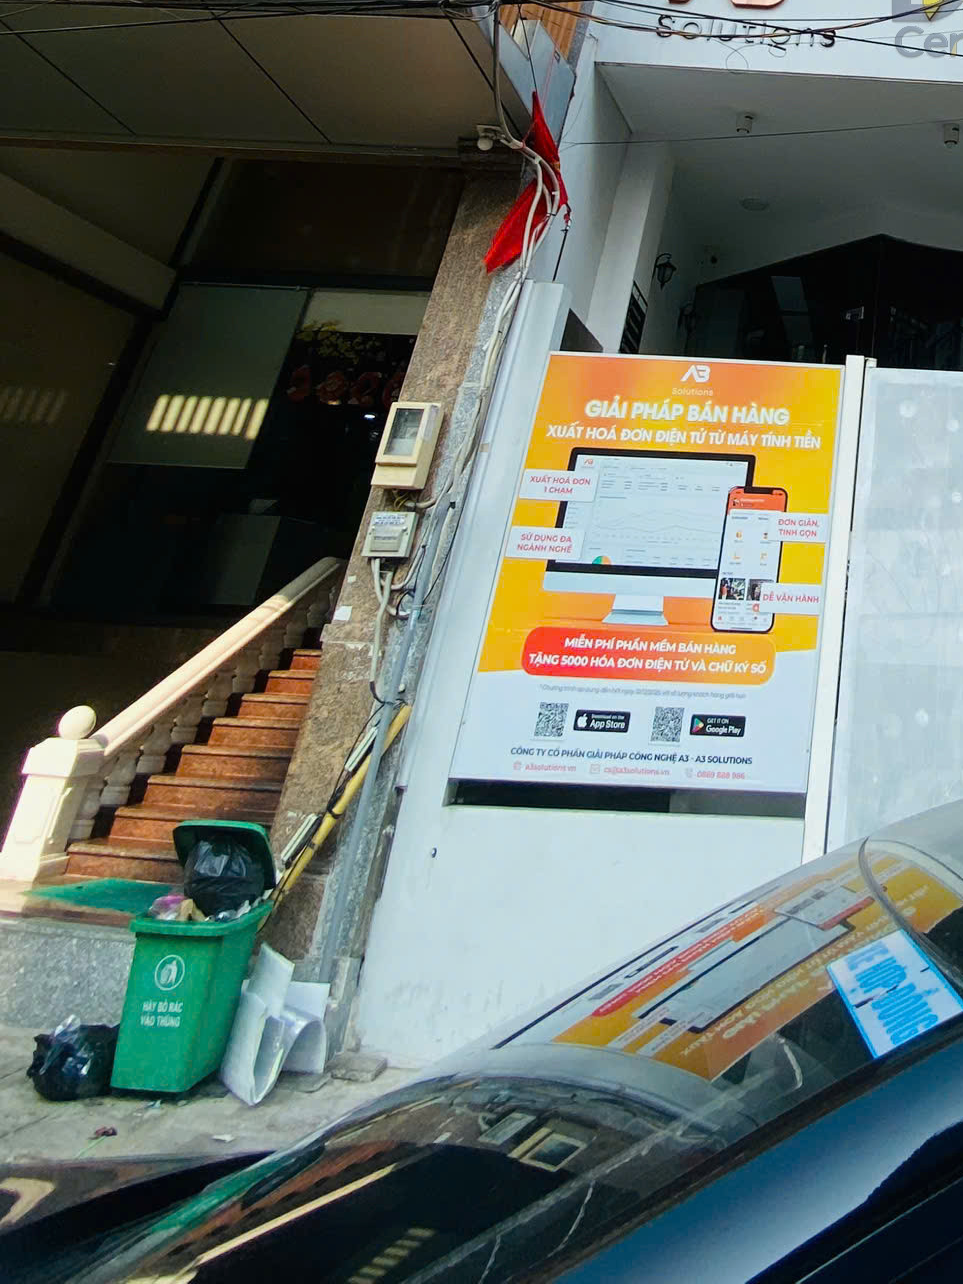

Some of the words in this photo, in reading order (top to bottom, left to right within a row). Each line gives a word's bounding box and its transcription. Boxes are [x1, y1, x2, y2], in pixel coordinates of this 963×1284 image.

[656, 14, 836, 48] Solutions
[671, 387, 714, 397] Solutions
[585, 394, 628, 419] GIẢI
[631, 398, 684, 421] PHÁP
[687, 400, 728, 423] BÁN
[731, 401, 790, 425] HÀNG
[546, 421, 584, 438] XUẤT
[585, 424, 617, 440] HOÁ
[620, 427, 652, 442] ĐƠN
[655, 427, 687, 446] ĐIỆN
[690, 427, 707, 444] TỬ
[708, 429, 726, 444] TỪ
[727, 429, 758, 446] MÁY
[761, 431, 792, 448] TÍNH
[794, 429, 821, 449] TIỀN
[530, 474, 552, 483] XUẤT
[572, 476, 591, 485] ĐƠN
[778, 518, 797, 527] ĐƠN
[778, 529, 798, 537] TINH
[795, 594, 819, 603] HÀNH
[564, 634, 593, 648] MIỄN
[595, 637, 616, 650] PHÍ
[678, 641, 701, 653] BÁN
[704, 642, 737, 655] HÀNG
[529, 651, 559, 667] TẶNG
[560, 656, 588, 666] 5000
[590, 654, 615, 667] HÓA
[617, 656, 642, 669] ĐƠN
[645, 656, 672, 672] ĐIỆN
[674, 657, 691, 670] TỬ
[691, 659, 707, 672] VÀ
[708, 659, 734, 673] CHỮ
[734, 660, 750, 673] KÝ
[751, 660, 768, 674] SỐ
[589, 719, 605, 729] App
[606, 719, 626, 729] Store
[706, 725, 728, 735] Google
[728, 726, 742, 736] Play
[510, 746, 534, 756] CÔNG
[536, 748, 546, 756] TY
[586, 748, 603, 759] GIẢI
[604, 749, 628, 760] PHÁP
[628, 751, 653, 761] CÔNG
[653, 752, 677, 764] NGHỆ
[677, 754, 689, 763] A3
[695, 755, 706, 763] A3
[707, 756, 753, 764] SOLUTIONS
